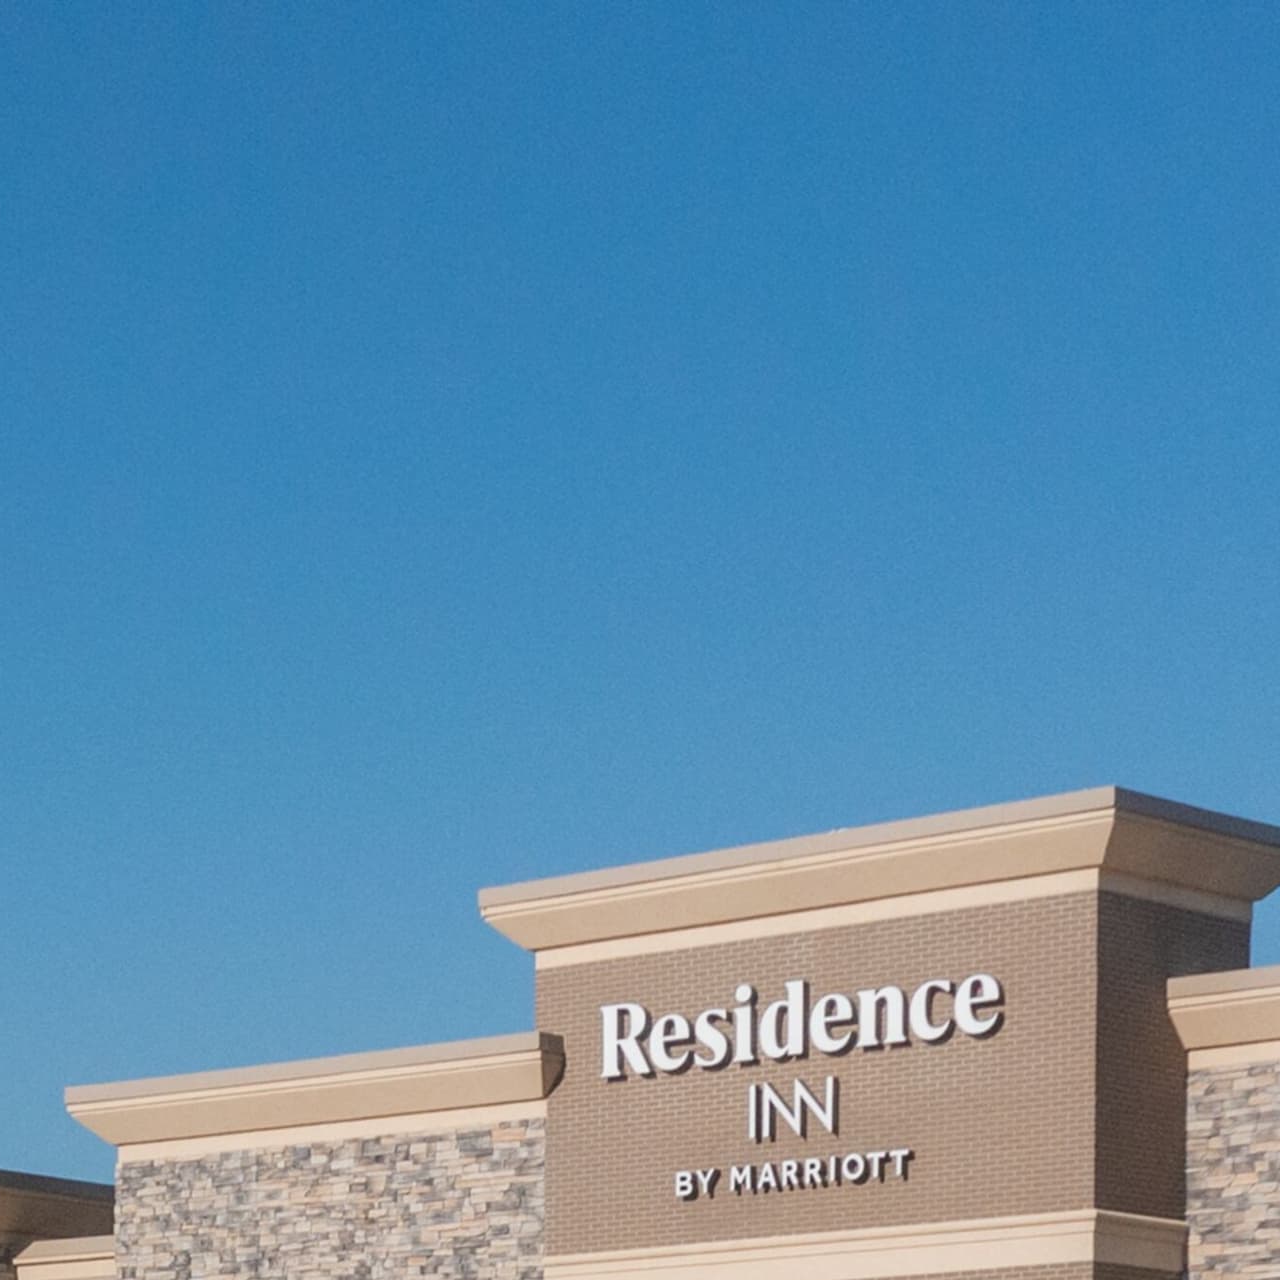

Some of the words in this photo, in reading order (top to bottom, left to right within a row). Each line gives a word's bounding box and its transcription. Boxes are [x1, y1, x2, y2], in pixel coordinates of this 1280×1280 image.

[600, 973, 1001, 1079] Residence
[747, 1075, 835, 1140] INN
[675, 1168, 715, 1198] BY
[730, 1148, 912, 1192] MARRIOTT
